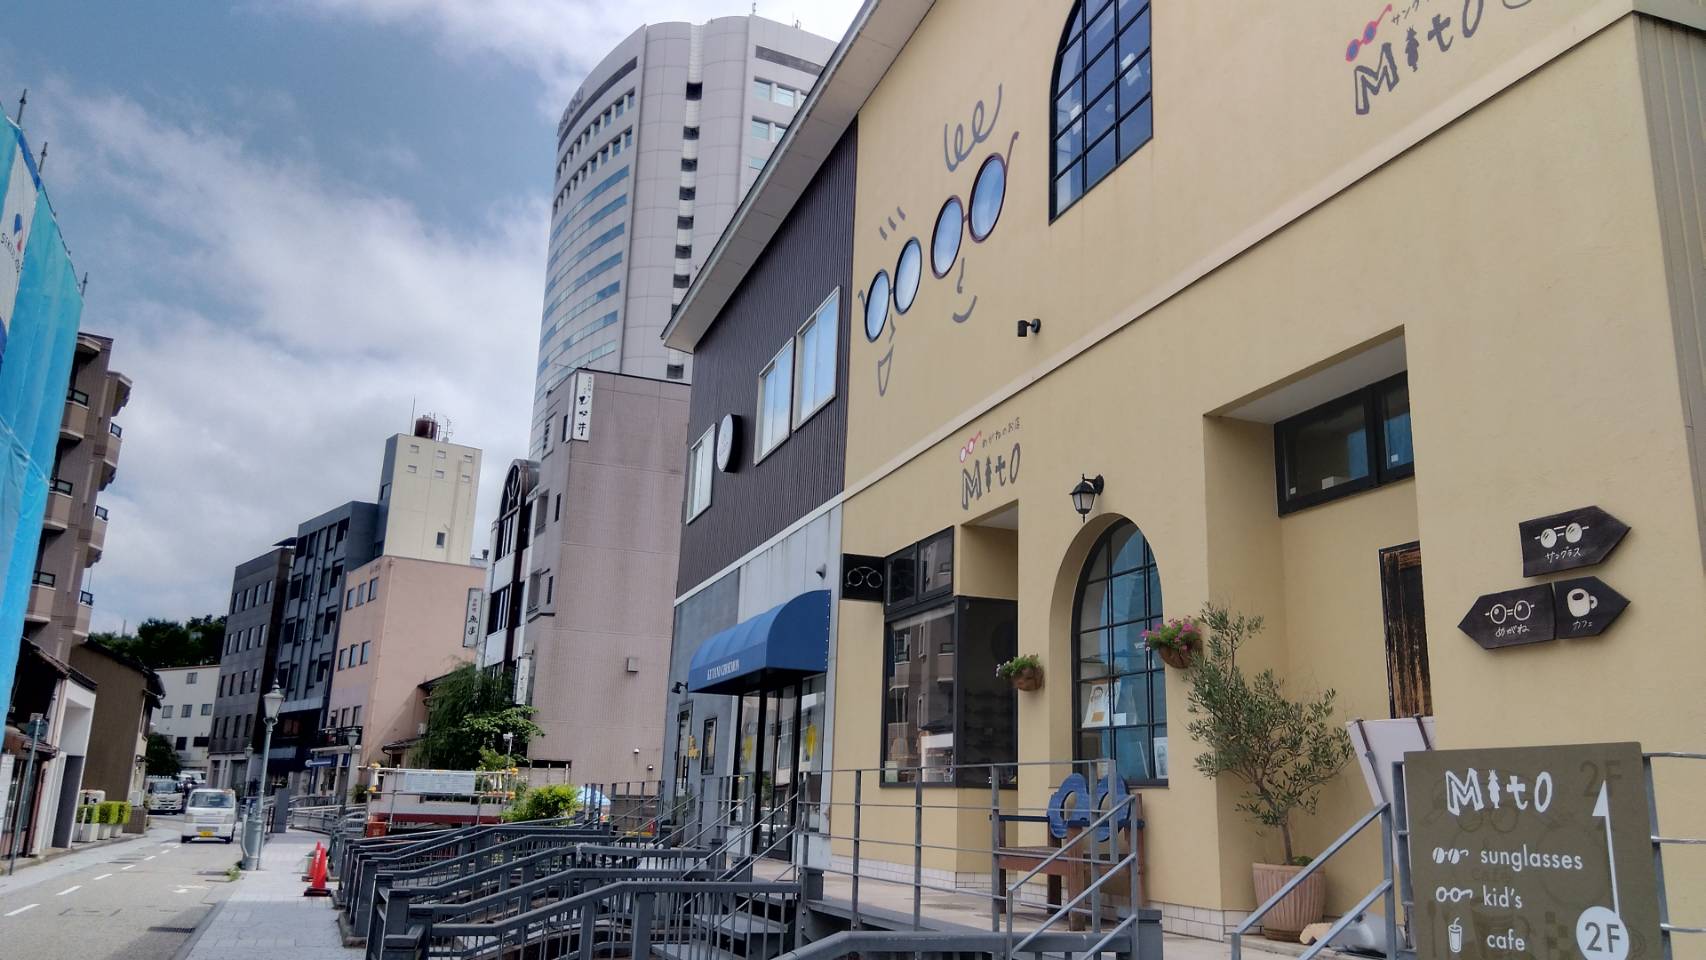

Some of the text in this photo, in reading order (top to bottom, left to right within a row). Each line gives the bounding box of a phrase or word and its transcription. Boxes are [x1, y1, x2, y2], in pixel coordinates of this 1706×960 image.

[1495, 623, 1530, 637] めがね
[1572, 620, 1593, 631] カフェ
[1480, 844, 1583, 872] sunglasses
[1482, 885, 1523, 909] kid's
[1486, 928, 1526, 951] cafe
[1584, 921, 1621, 953] 2F
